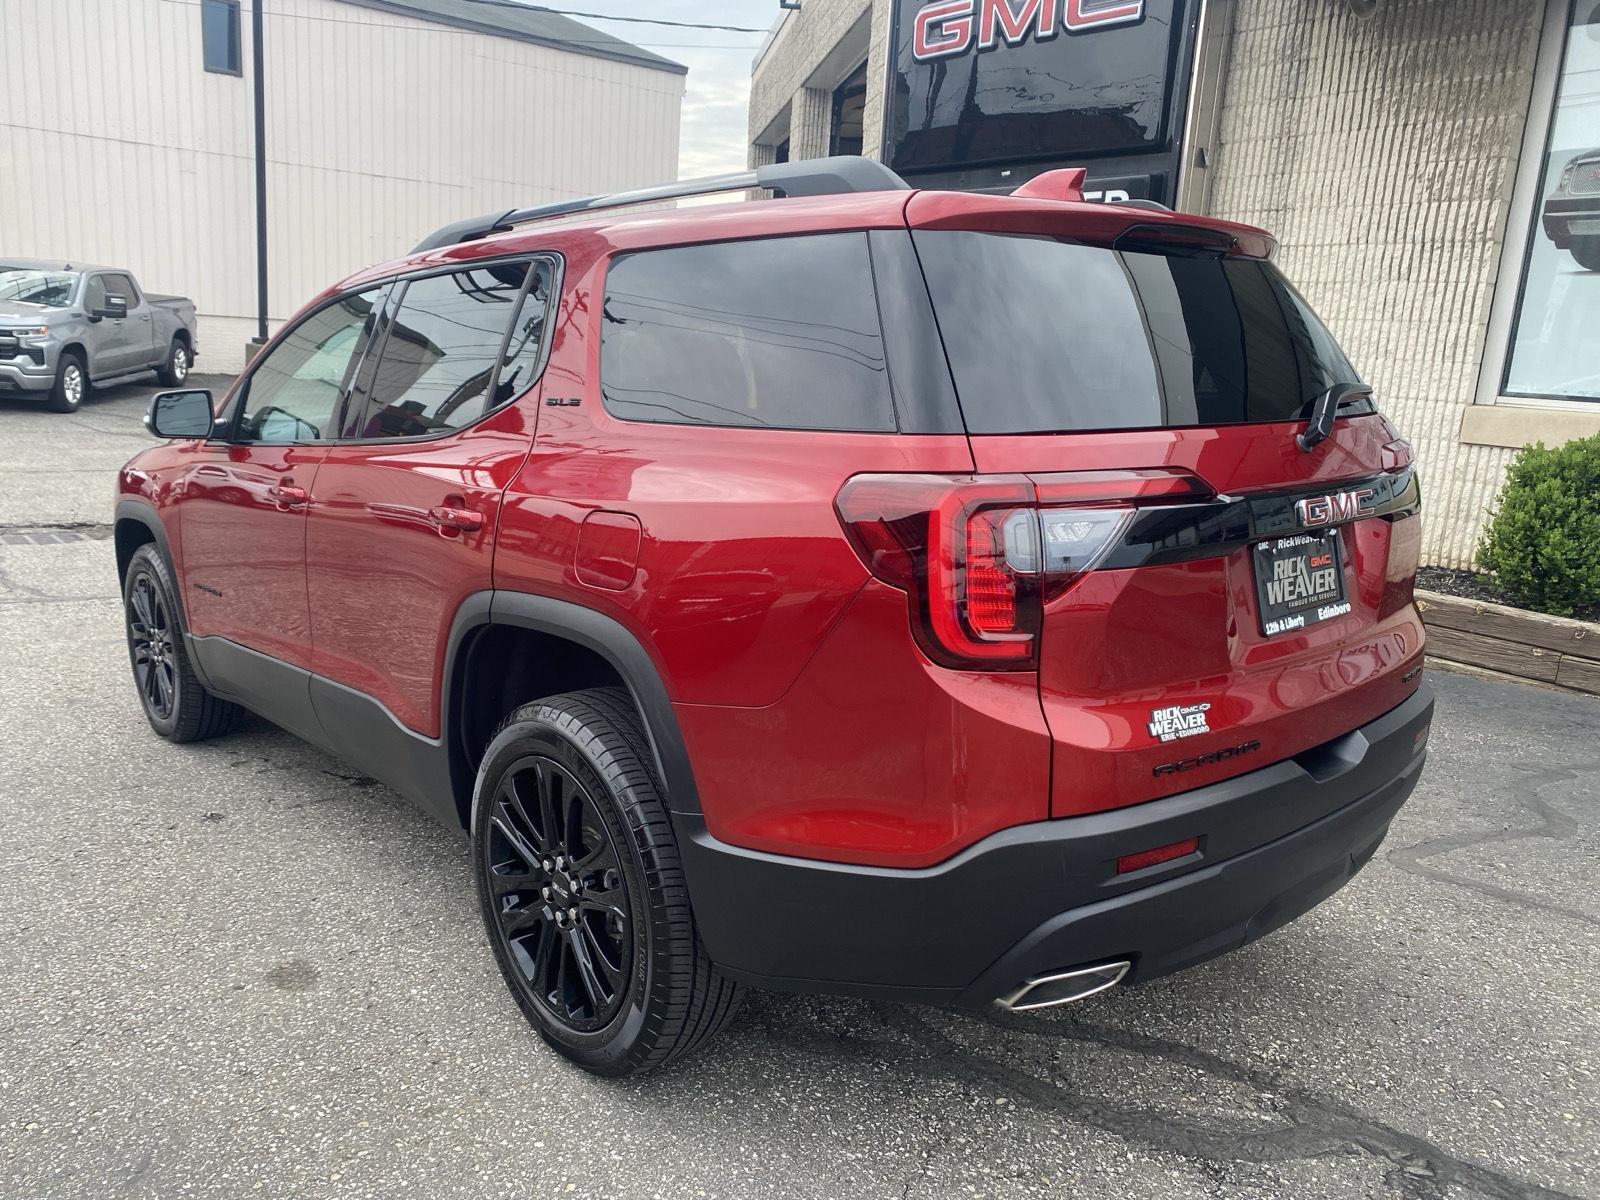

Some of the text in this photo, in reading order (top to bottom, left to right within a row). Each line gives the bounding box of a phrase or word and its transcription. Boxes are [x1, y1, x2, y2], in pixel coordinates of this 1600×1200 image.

[545, 398, 582, 407] SLE
[1301, 489, 1374, 526] GMC
[1273, 556, 1306, 581] RICK
[1311, 554, 1331, 568] GMC
[1266, 567, 1336, 606] WEAVER
[1317, 603, 1351, 620] Edinboro
[1265, 615, 1305, 635] 12th & Liberty
[1152, 706, 1182, 722] RICK
[1180, 705, 1199, 714] GMC
[1149, 712, 1207, 736] WEAVER
[1161, 725, 1210, 742] ERIE EDINBORO
[1153, 740, 1260, 777] ACADIA
